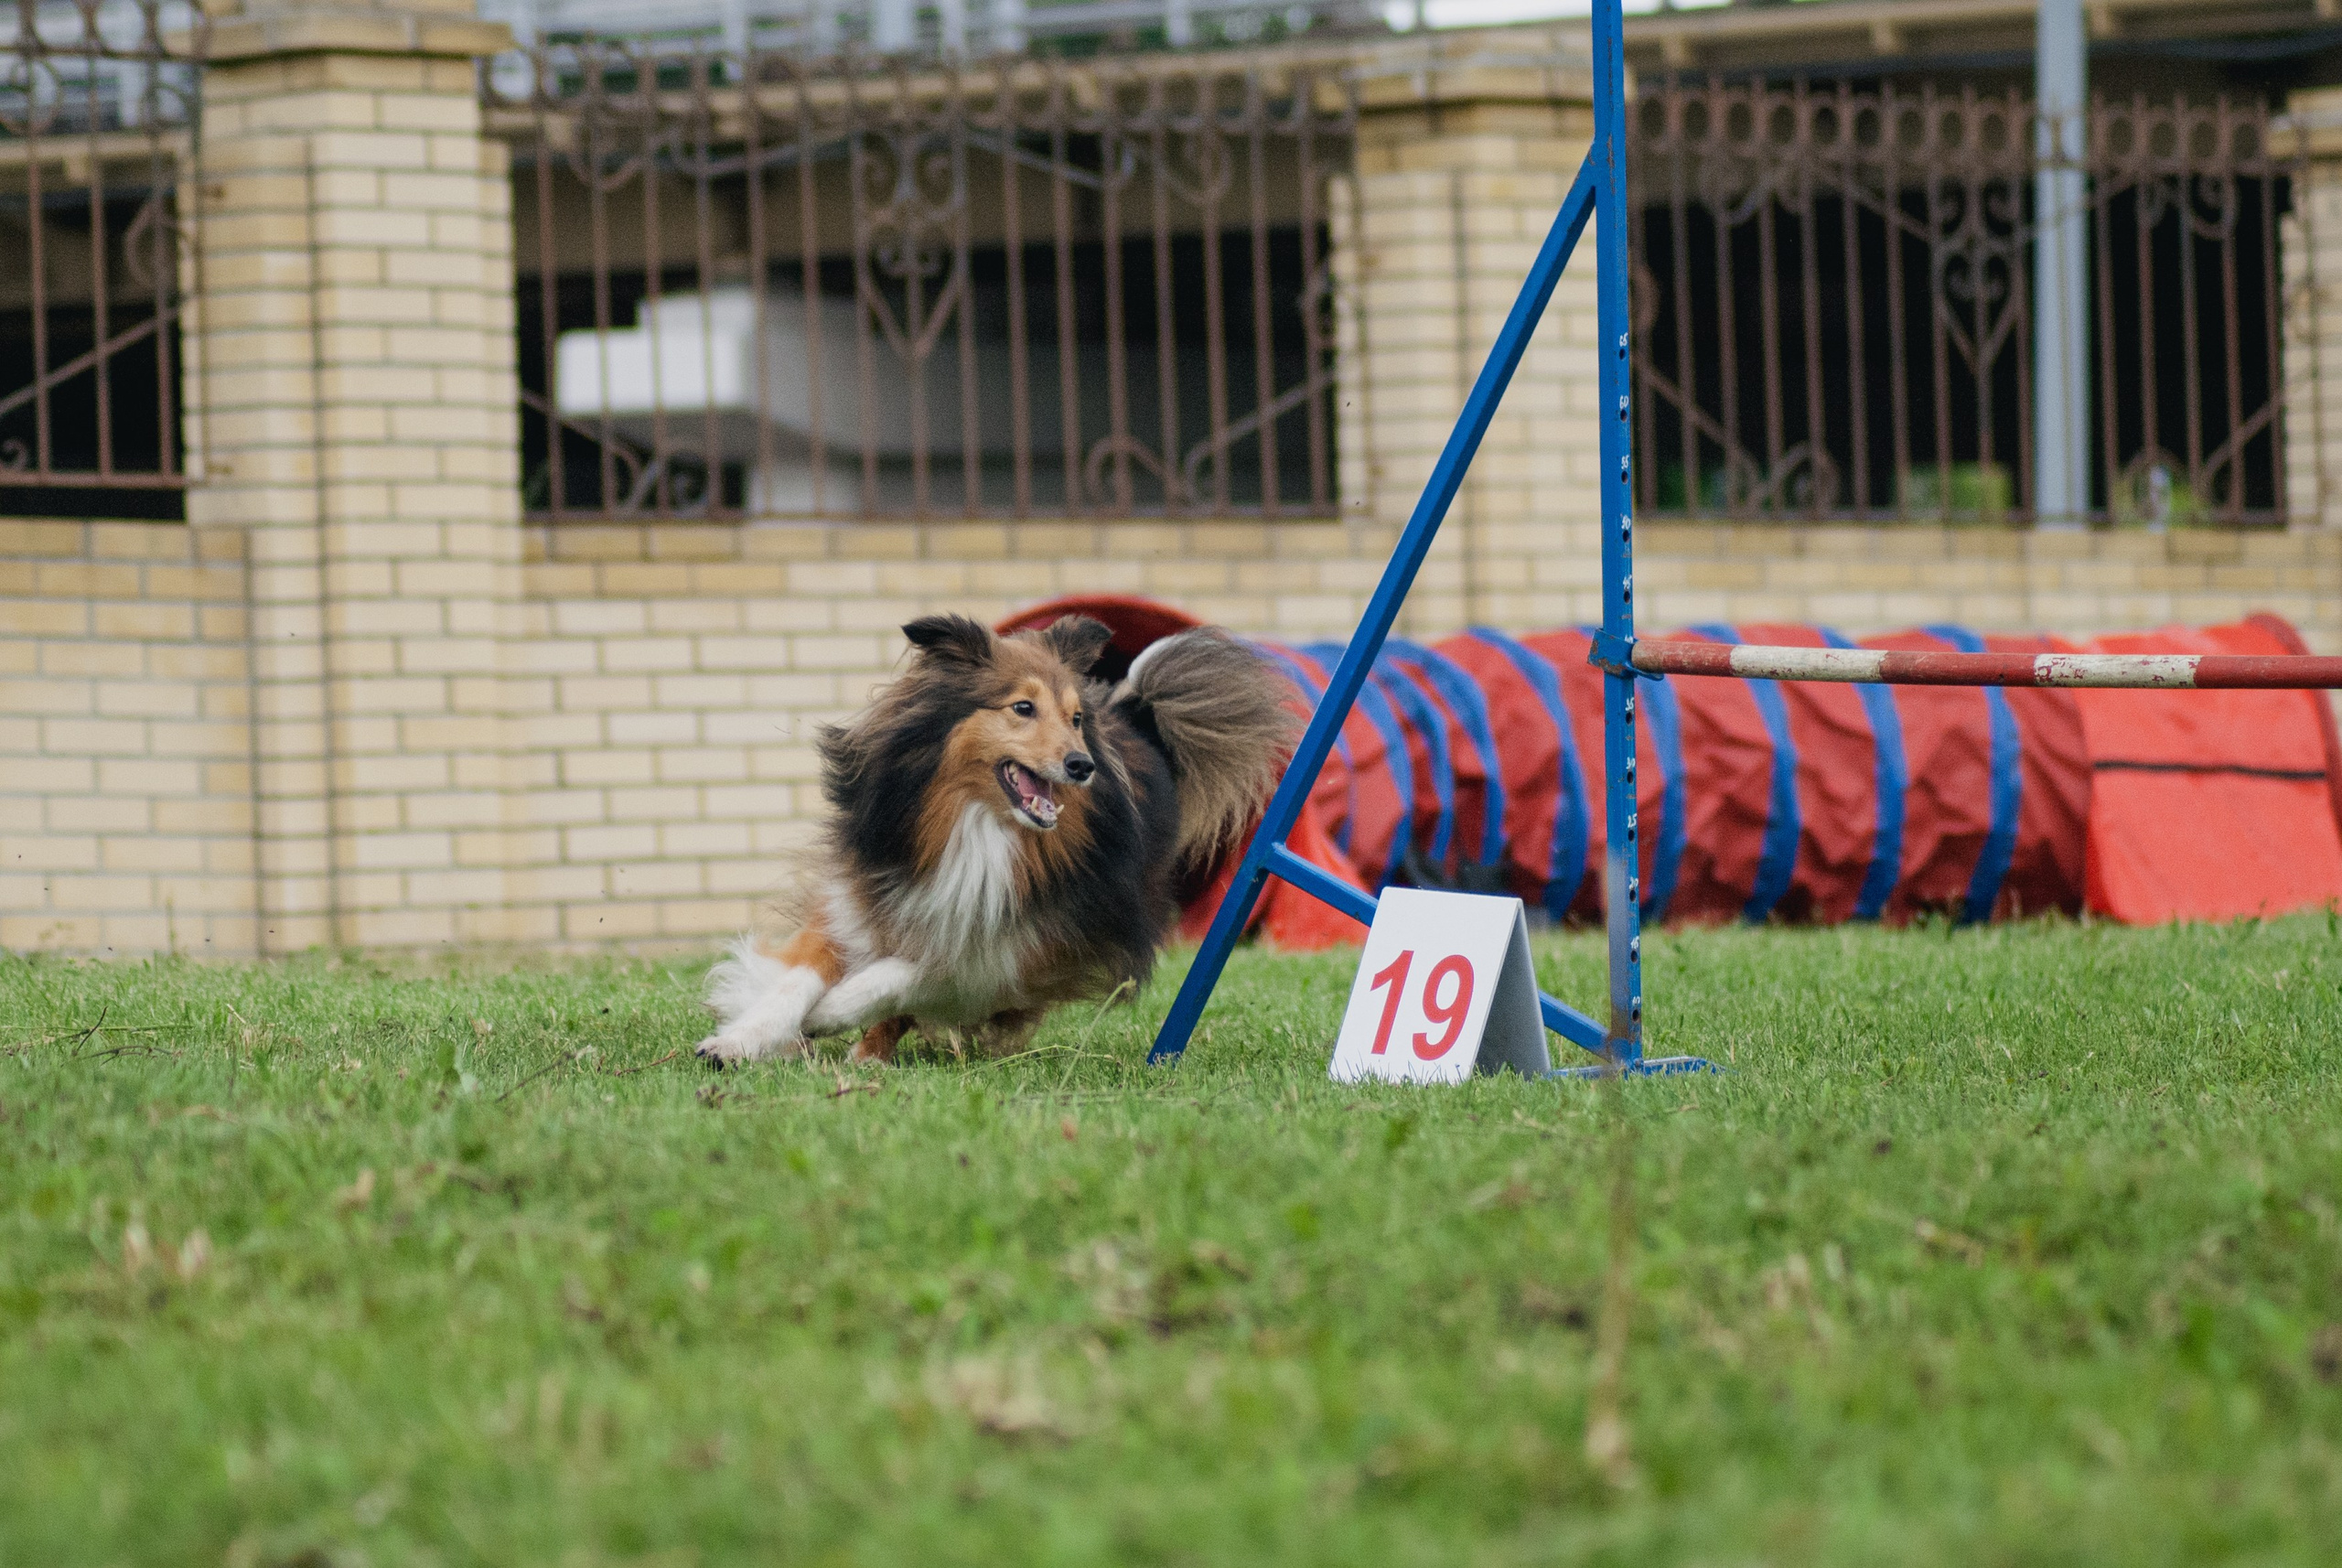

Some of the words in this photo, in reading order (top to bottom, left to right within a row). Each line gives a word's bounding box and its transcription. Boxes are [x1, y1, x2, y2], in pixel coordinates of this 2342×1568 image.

[1619, 333, 1628, 347] 65
[1619, 395, 1629, 409] 60
[1626, 698, 1635, 711] 35
[1626, 757, 1636, 769] 30
[1628, 814, 1638, 828] 25
[1370, 950, 1475, 1061] 19
